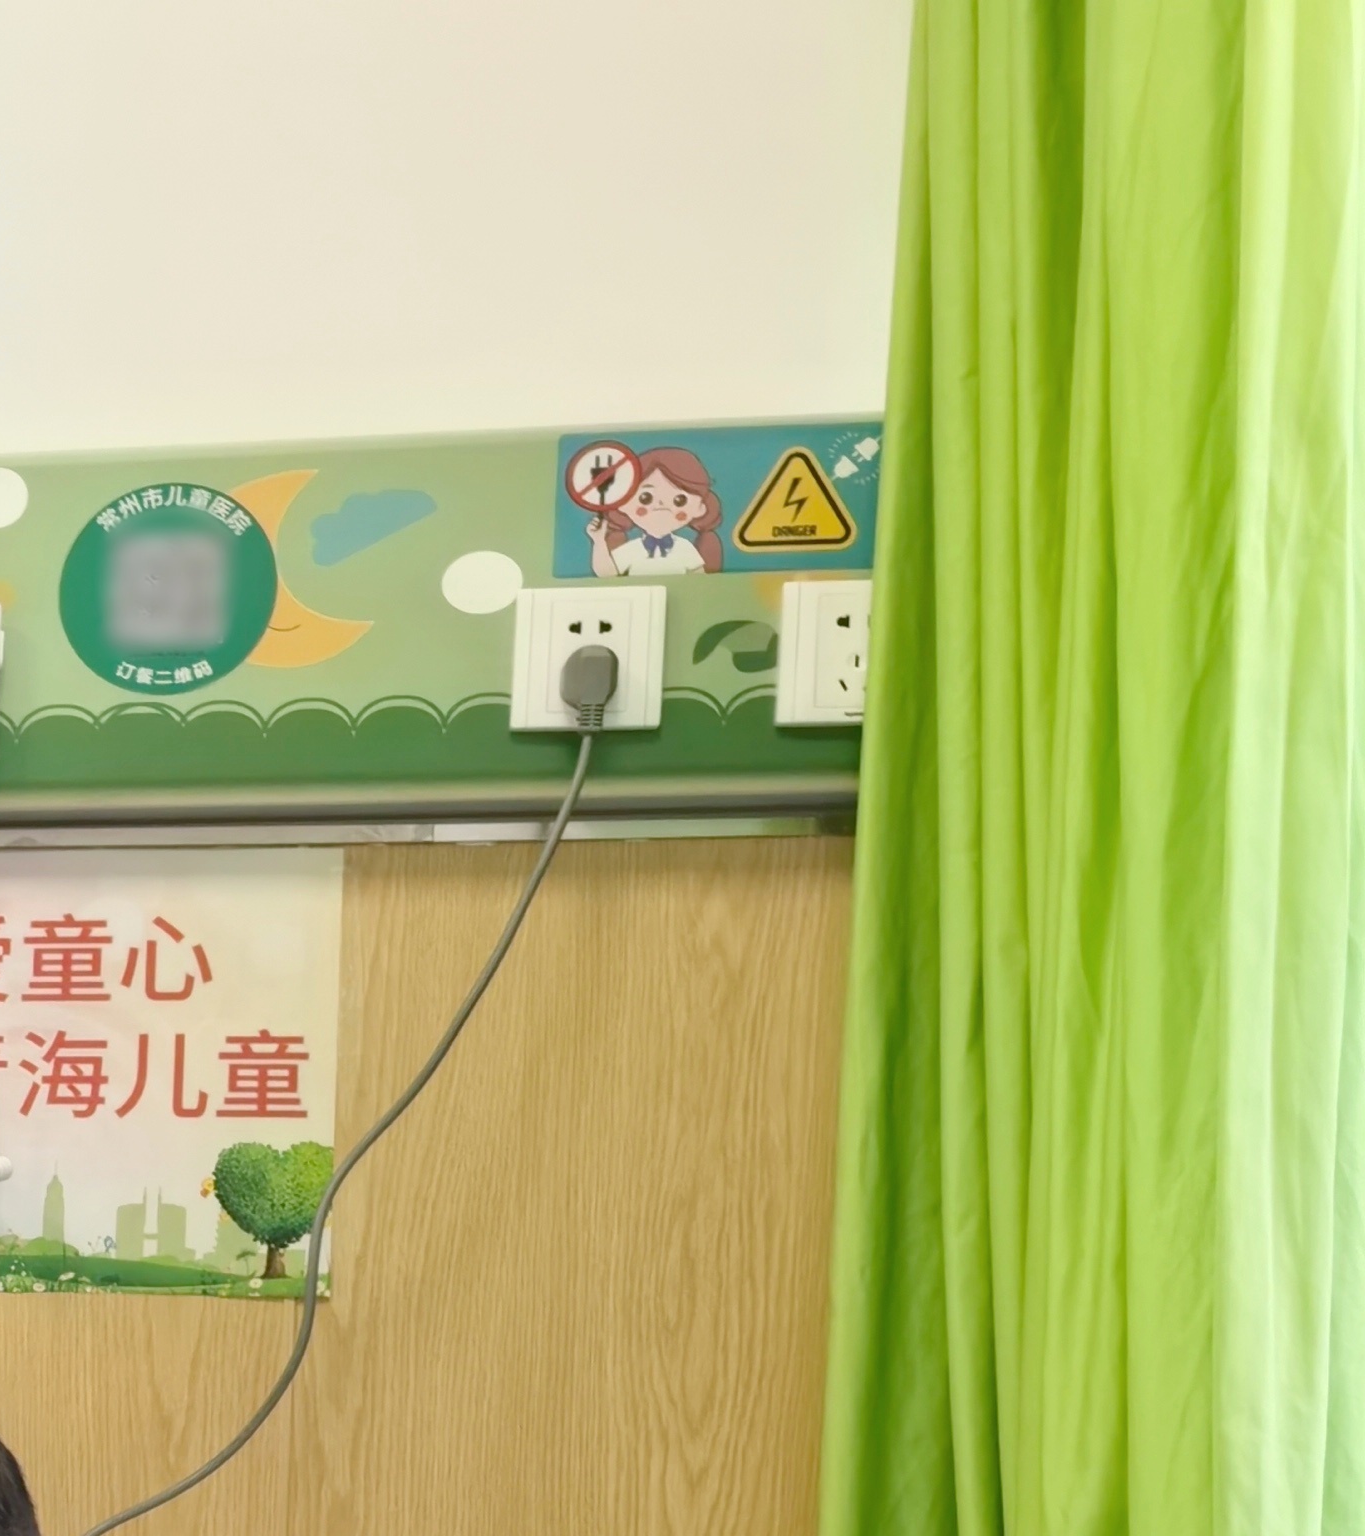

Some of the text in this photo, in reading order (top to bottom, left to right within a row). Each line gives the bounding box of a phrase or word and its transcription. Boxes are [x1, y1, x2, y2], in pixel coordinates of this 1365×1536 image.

[96, 485, 253, 536] 常州市儿童医院
[771, 525, 817, 538] DANGER
[115, 660, 214, 685] 订餐二维码
